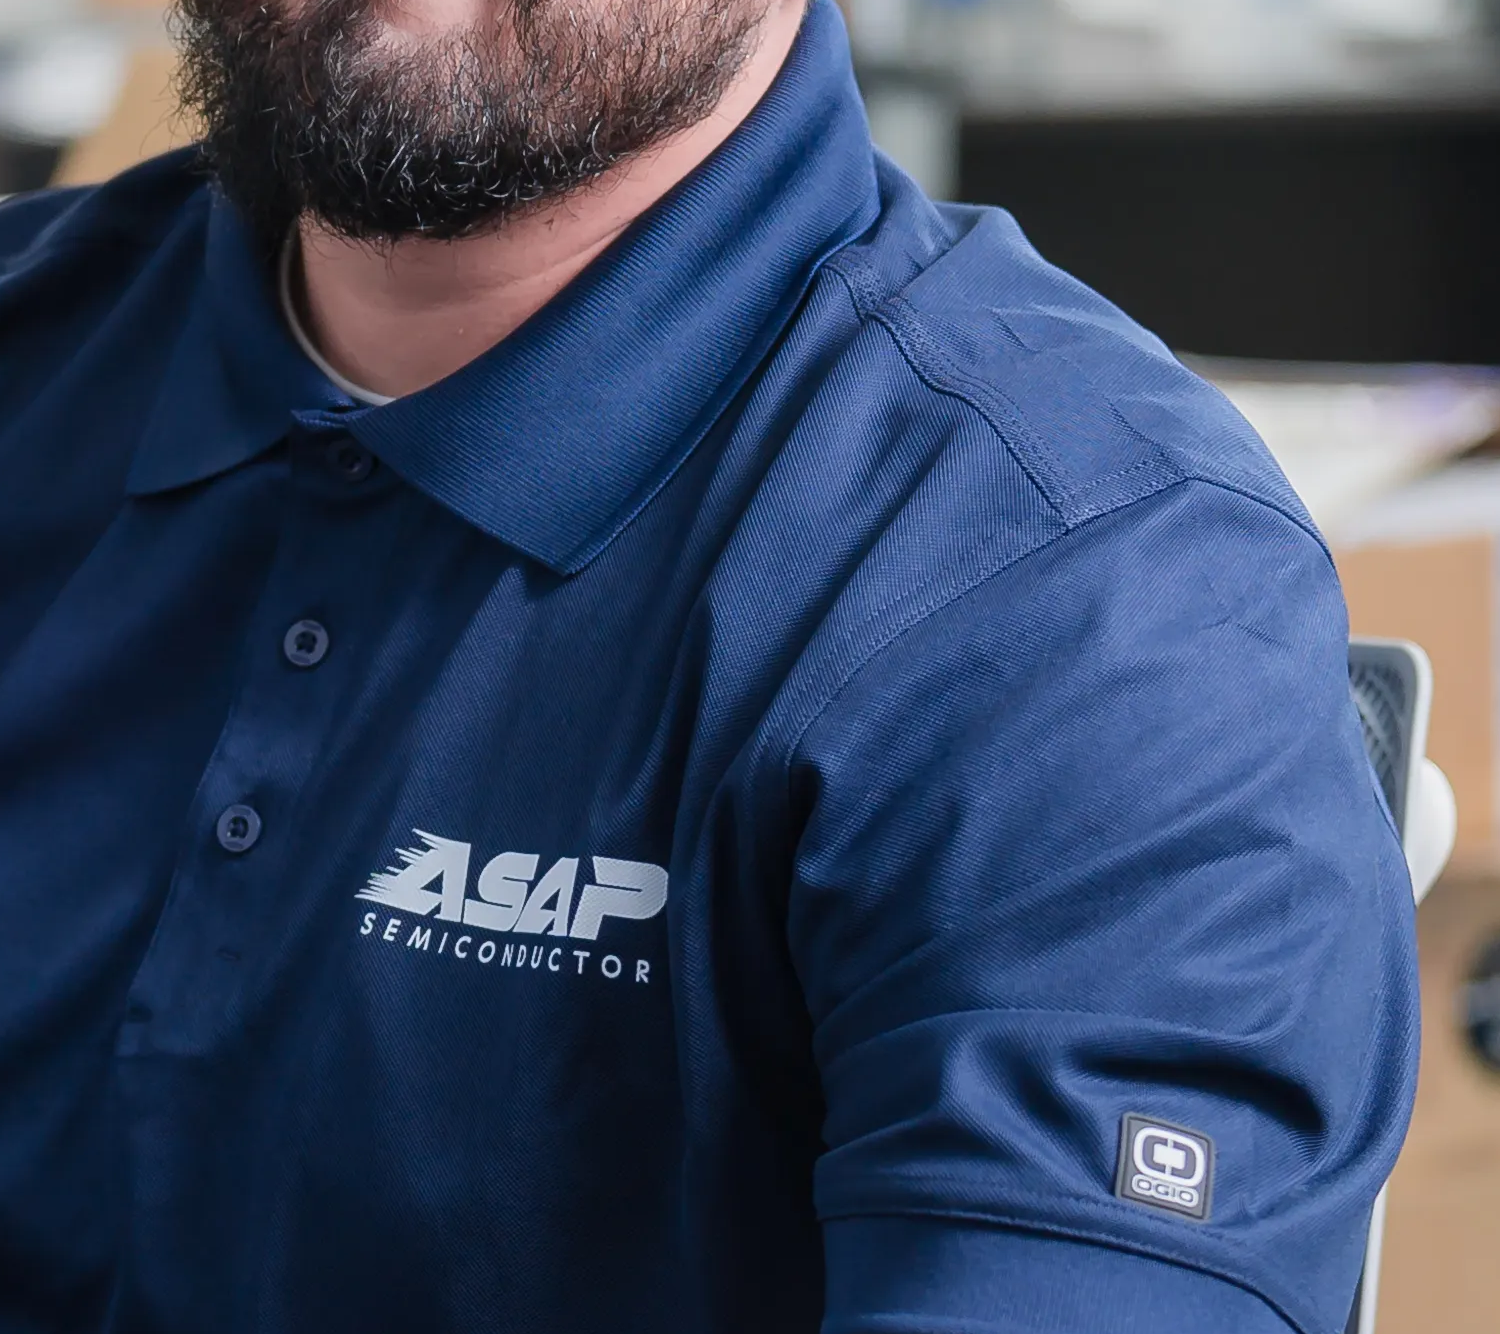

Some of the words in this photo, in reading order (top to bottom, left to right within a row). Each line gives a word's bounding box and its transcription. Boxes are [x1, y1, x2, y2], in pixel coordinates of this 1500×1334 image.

[353, 828, 669, 941] ASAP
[359, 912, 651, 984] SEMICONDUCTOR
[1136, 1178, 1195, 1204] OGIO
